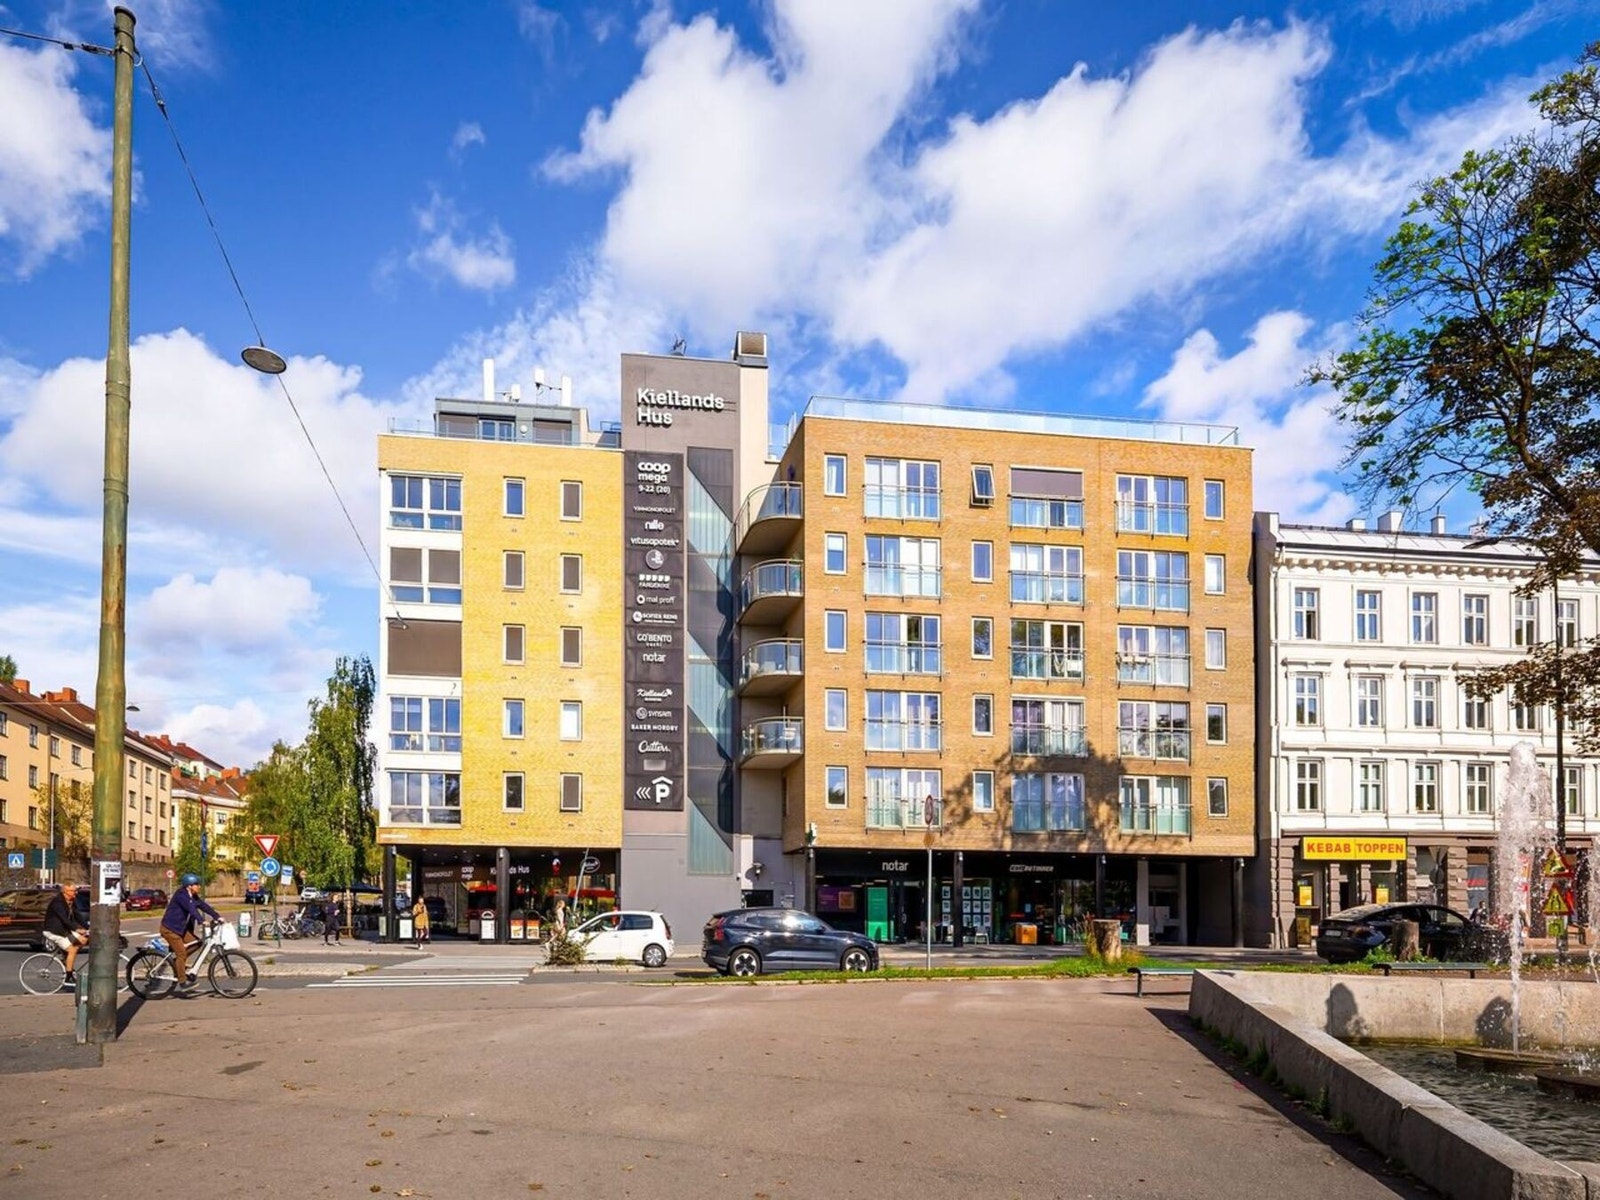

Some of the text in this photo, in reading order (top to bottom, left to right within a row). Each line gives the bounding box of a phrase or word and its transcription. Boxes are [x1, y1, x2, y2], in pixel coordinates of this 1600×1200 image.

[637, 388, 725, 409] Kiellands
[637, 407, 673, 425] Hus
[638, 462, 671, 474] coop
[638, 473, 668, 484] mega
[638, 485, 671, 495] 9-22 (20)
[633, 505, 676, 514] VINMONOPOLET
[644, 519, 665, 531] nille
[630, 537, 677, 547] vitusapotek
[642, 651, 667, 662] notar
[1306, 842, 1404, 854] KEBAB TOPPEN
[881, 860, 909, 871] notar
